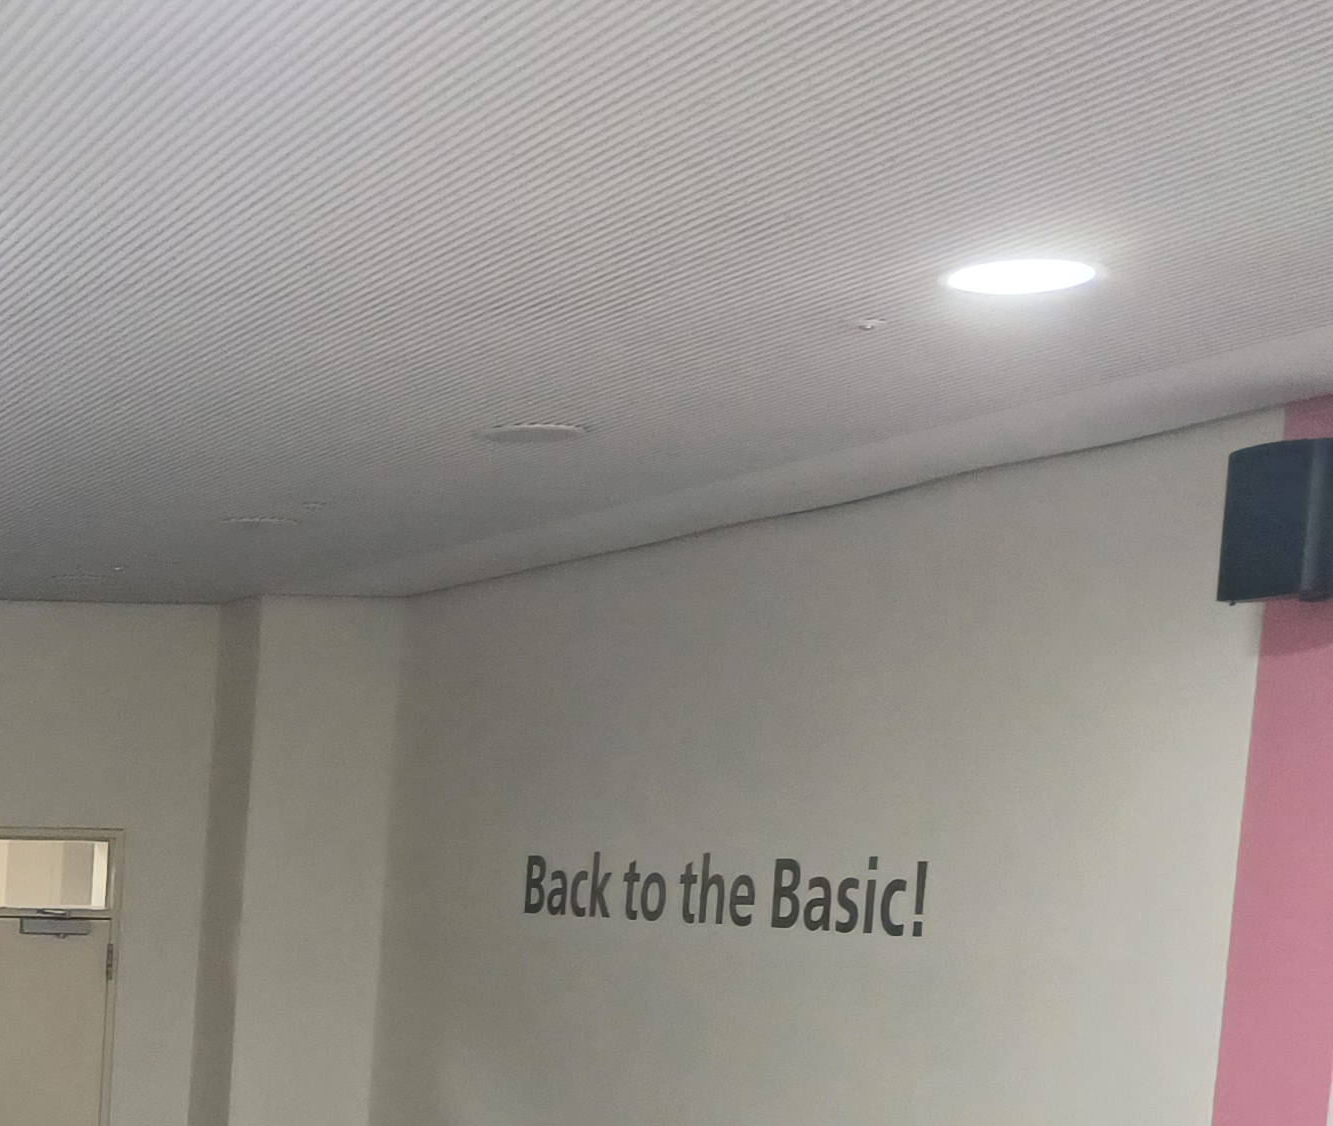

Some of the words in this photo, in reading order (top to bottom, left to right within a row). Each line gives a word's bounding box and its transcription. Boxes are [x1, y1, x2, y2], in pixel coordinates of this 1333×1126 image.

[524, 851, 612, 918] Back
[623, 859, 667, 922] to
[679, 852, 755, 927] the
[771, 856, 929, 937] Basic!
